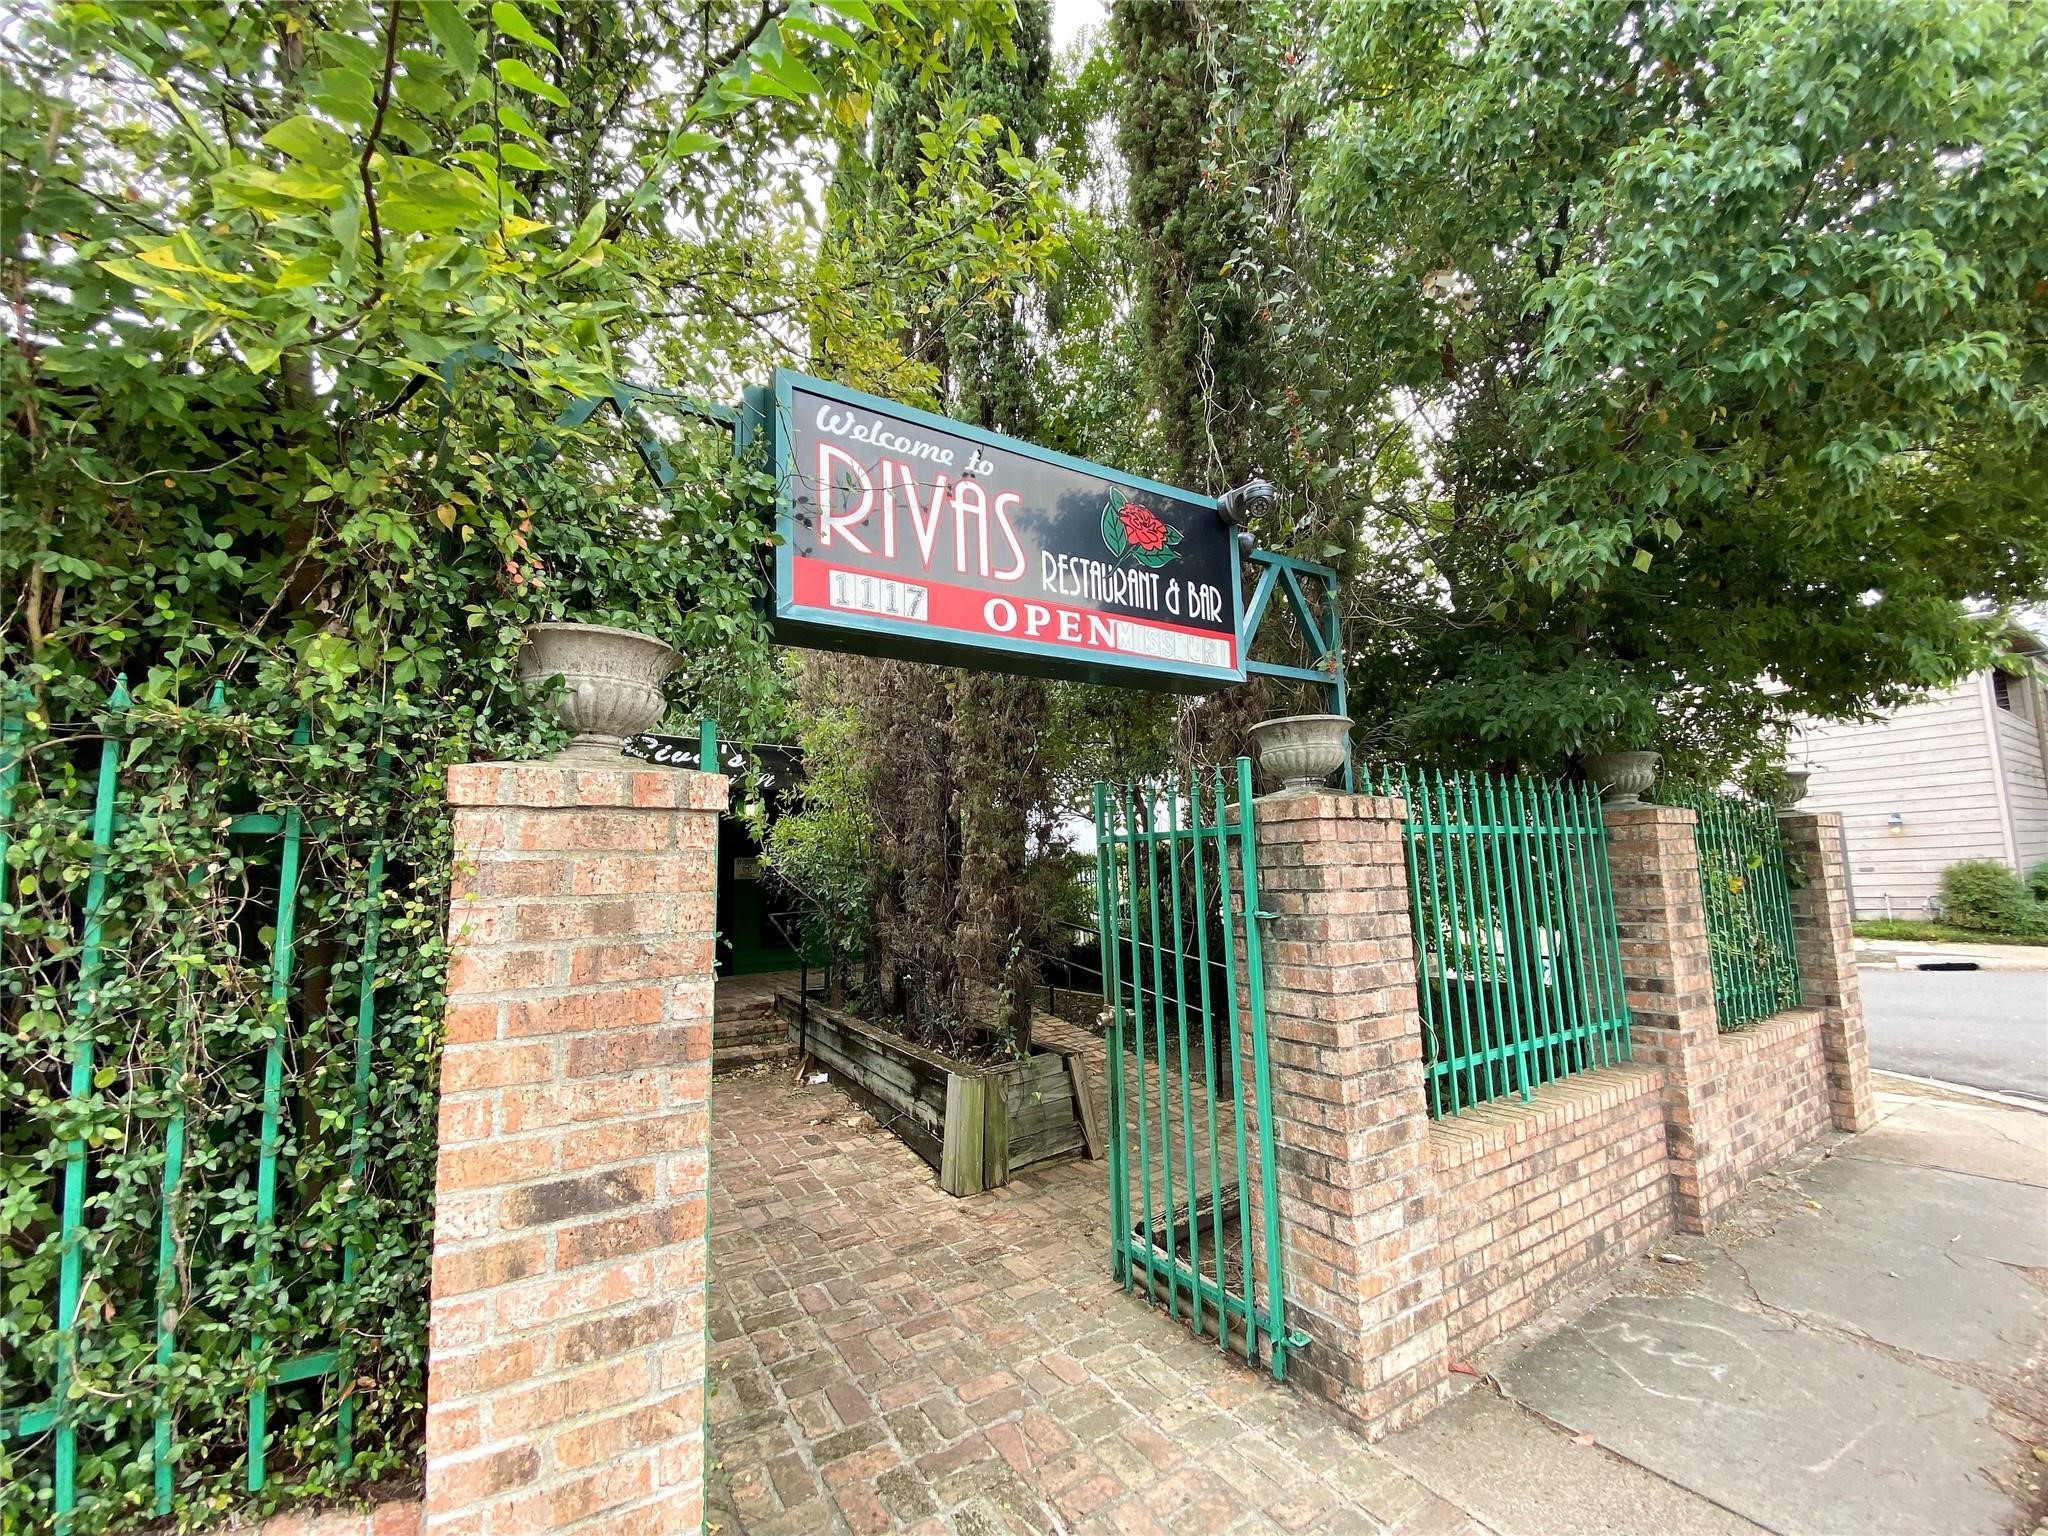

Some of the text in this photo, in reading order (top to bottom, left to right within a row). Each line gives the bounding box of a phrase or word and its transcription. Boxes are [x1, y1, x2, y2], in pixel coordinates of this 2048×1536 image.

[815, 404, 994, 477] Welcome to
[818, 441, 1026, 581] RIVAS
[834, 571, 926, 618] 1117
[983, 597, 1116, 649] OPEN
[1041, 550, 1223, 623] RESTAURANT & BAR
